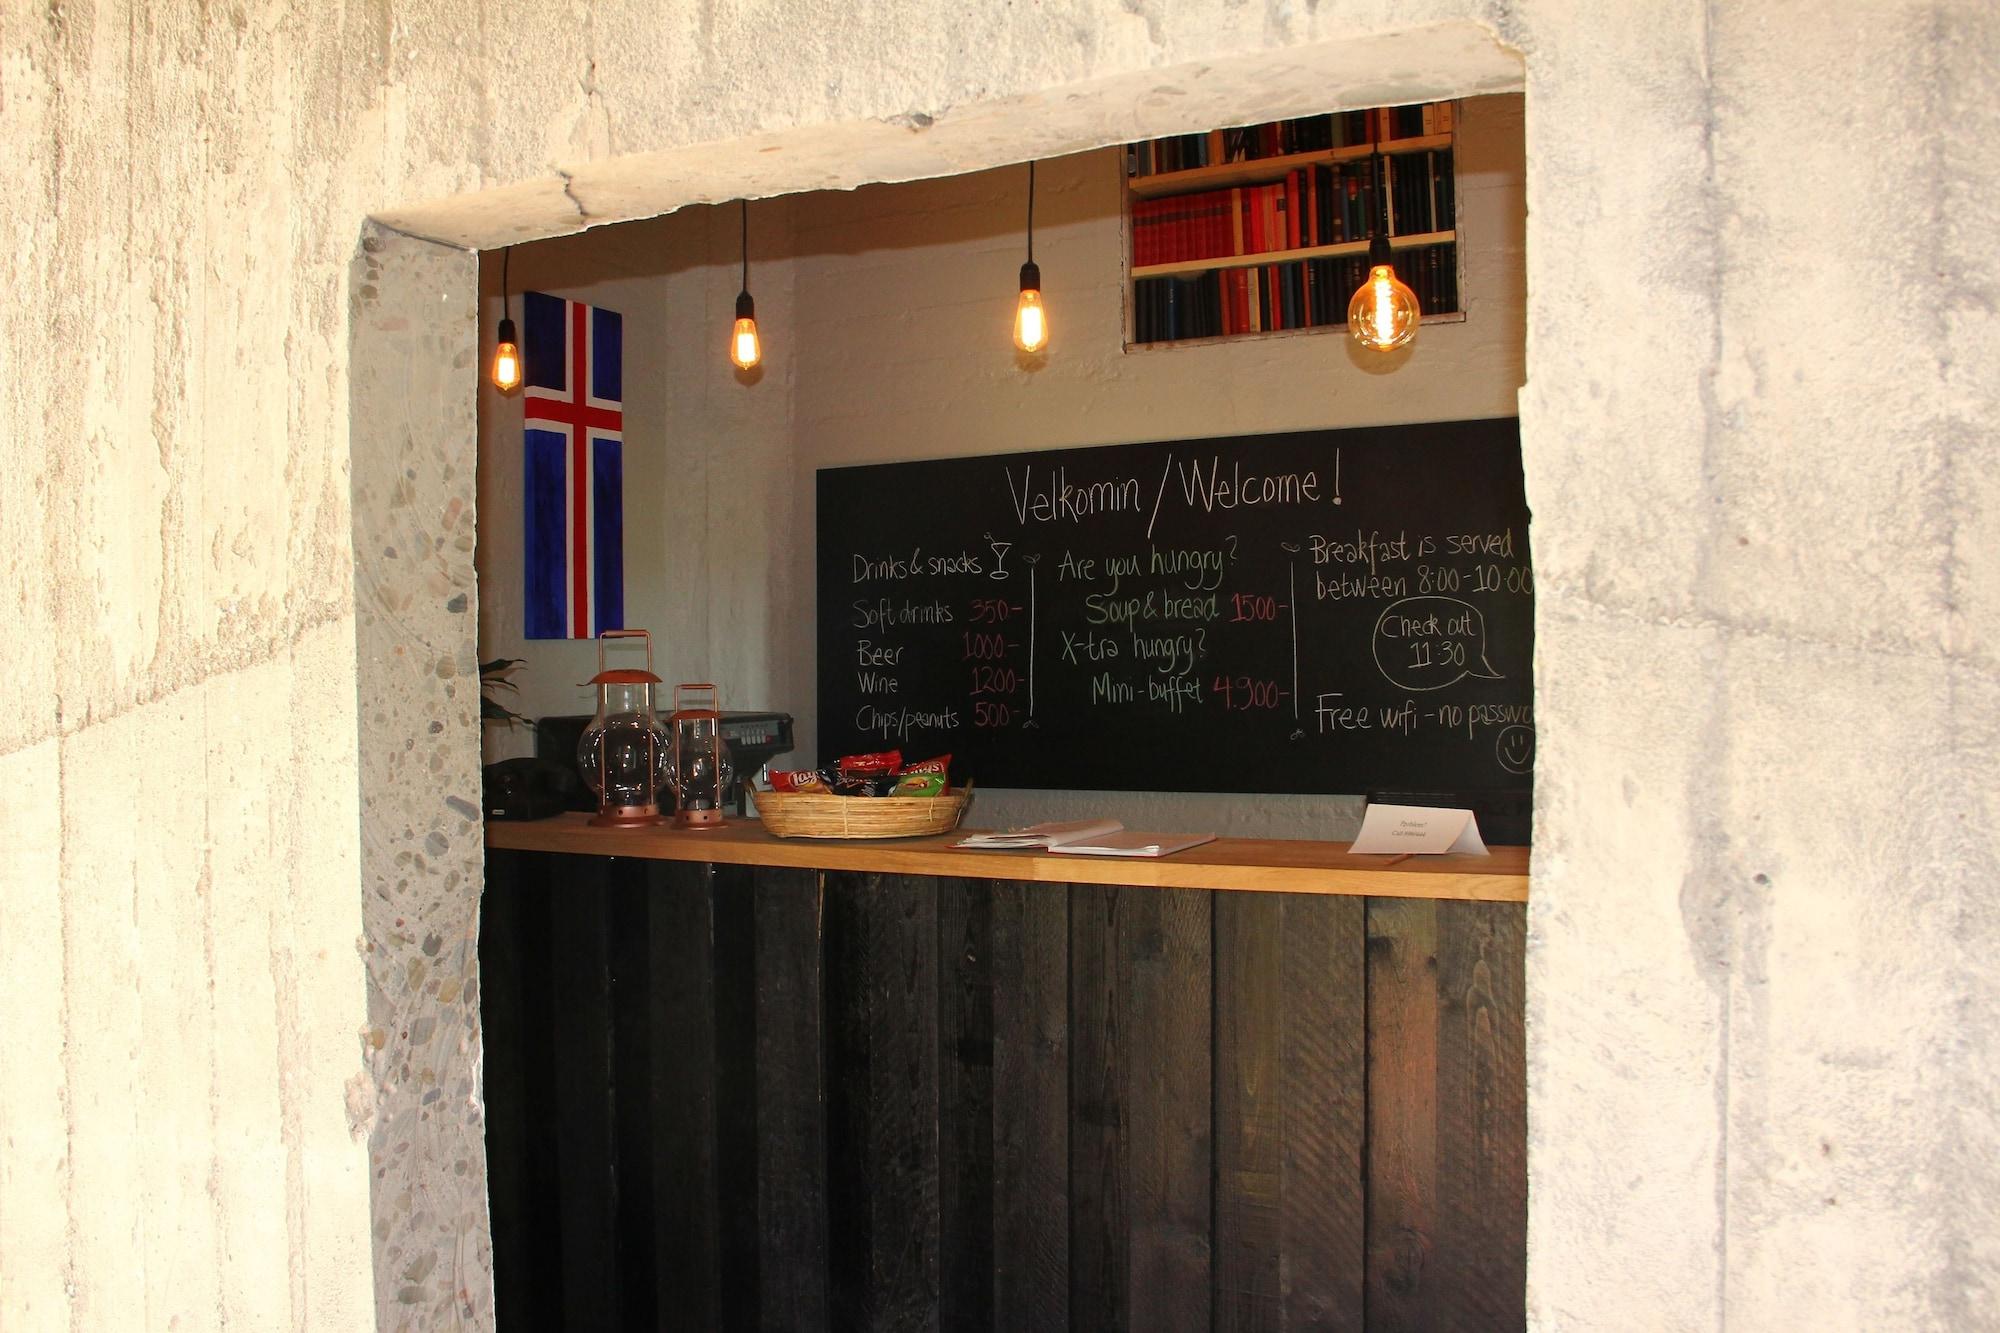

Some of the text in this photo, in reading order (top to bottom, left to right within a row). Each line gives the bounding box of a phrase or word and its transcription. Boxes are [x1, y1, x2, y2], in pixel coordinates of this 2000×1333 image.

[1005, 464, 1141, 525] Velkomin
[852, 548, 983, 583] Drinks & snacks
[1058, 535, 1238, 597] Are you hungry?
[1309, 528, 1515, 575] Breakfast is served
[1315, 570, 1407, 600] between
[852, 598, 896, 634] Soft
[899, 600, 954, 624] drinks
[1085, 593, 1141, 632] Soup
[1143, 590, 1158, 618] &
[1164, 588, 1220, 621] bread
[1380, 610, 1476, 638] Check out
[857, 639, 905, 666] Beer
[1061, 627, 1207, 675] X-tra hungry?
[1407, 641, 1466, 668] 11:30
[857, 671, 899, 694] Wine
[1315, 692, 1372, 734] Free
[1379, 699, 1418, 736] wifi
[1438, 704, 1463, 729] no
